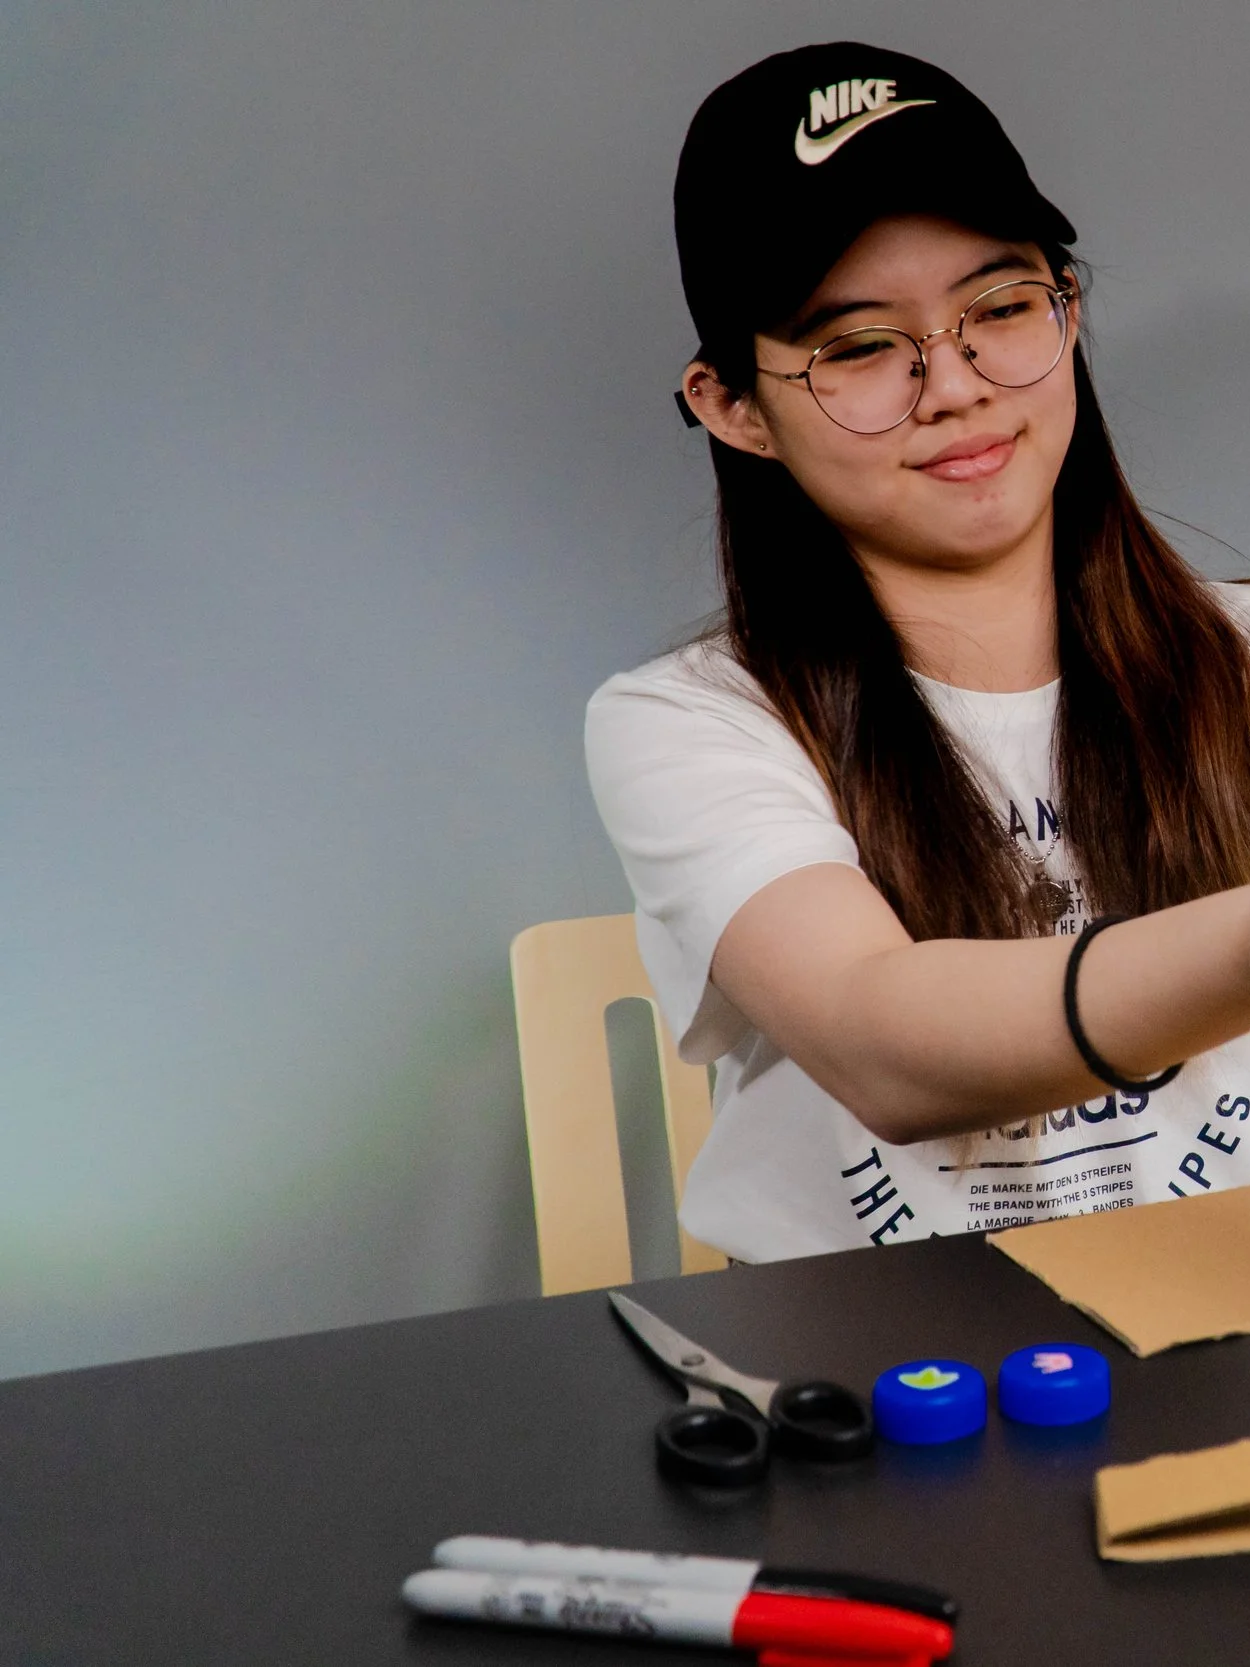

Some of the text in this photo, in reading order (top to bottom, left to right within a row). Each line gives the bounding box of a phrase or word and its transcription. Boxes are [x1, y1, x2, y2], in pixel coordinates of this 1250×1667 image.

[809, 78, 897, 132] NIKE
[970, 1163, 1132, 1195] DIE MARKE MIT DEN 3 STREIFEN
[841, 1147, 915, 1246] THE
[968, 1180, 1134, 1212] THE BRAND WITH THE 3 STRIPES
[967, 1221, 981, 1231] LA
[984, 1216, 1034, 1229] MARQUE
[1093, 1198, 1134, 1213] BANDES
